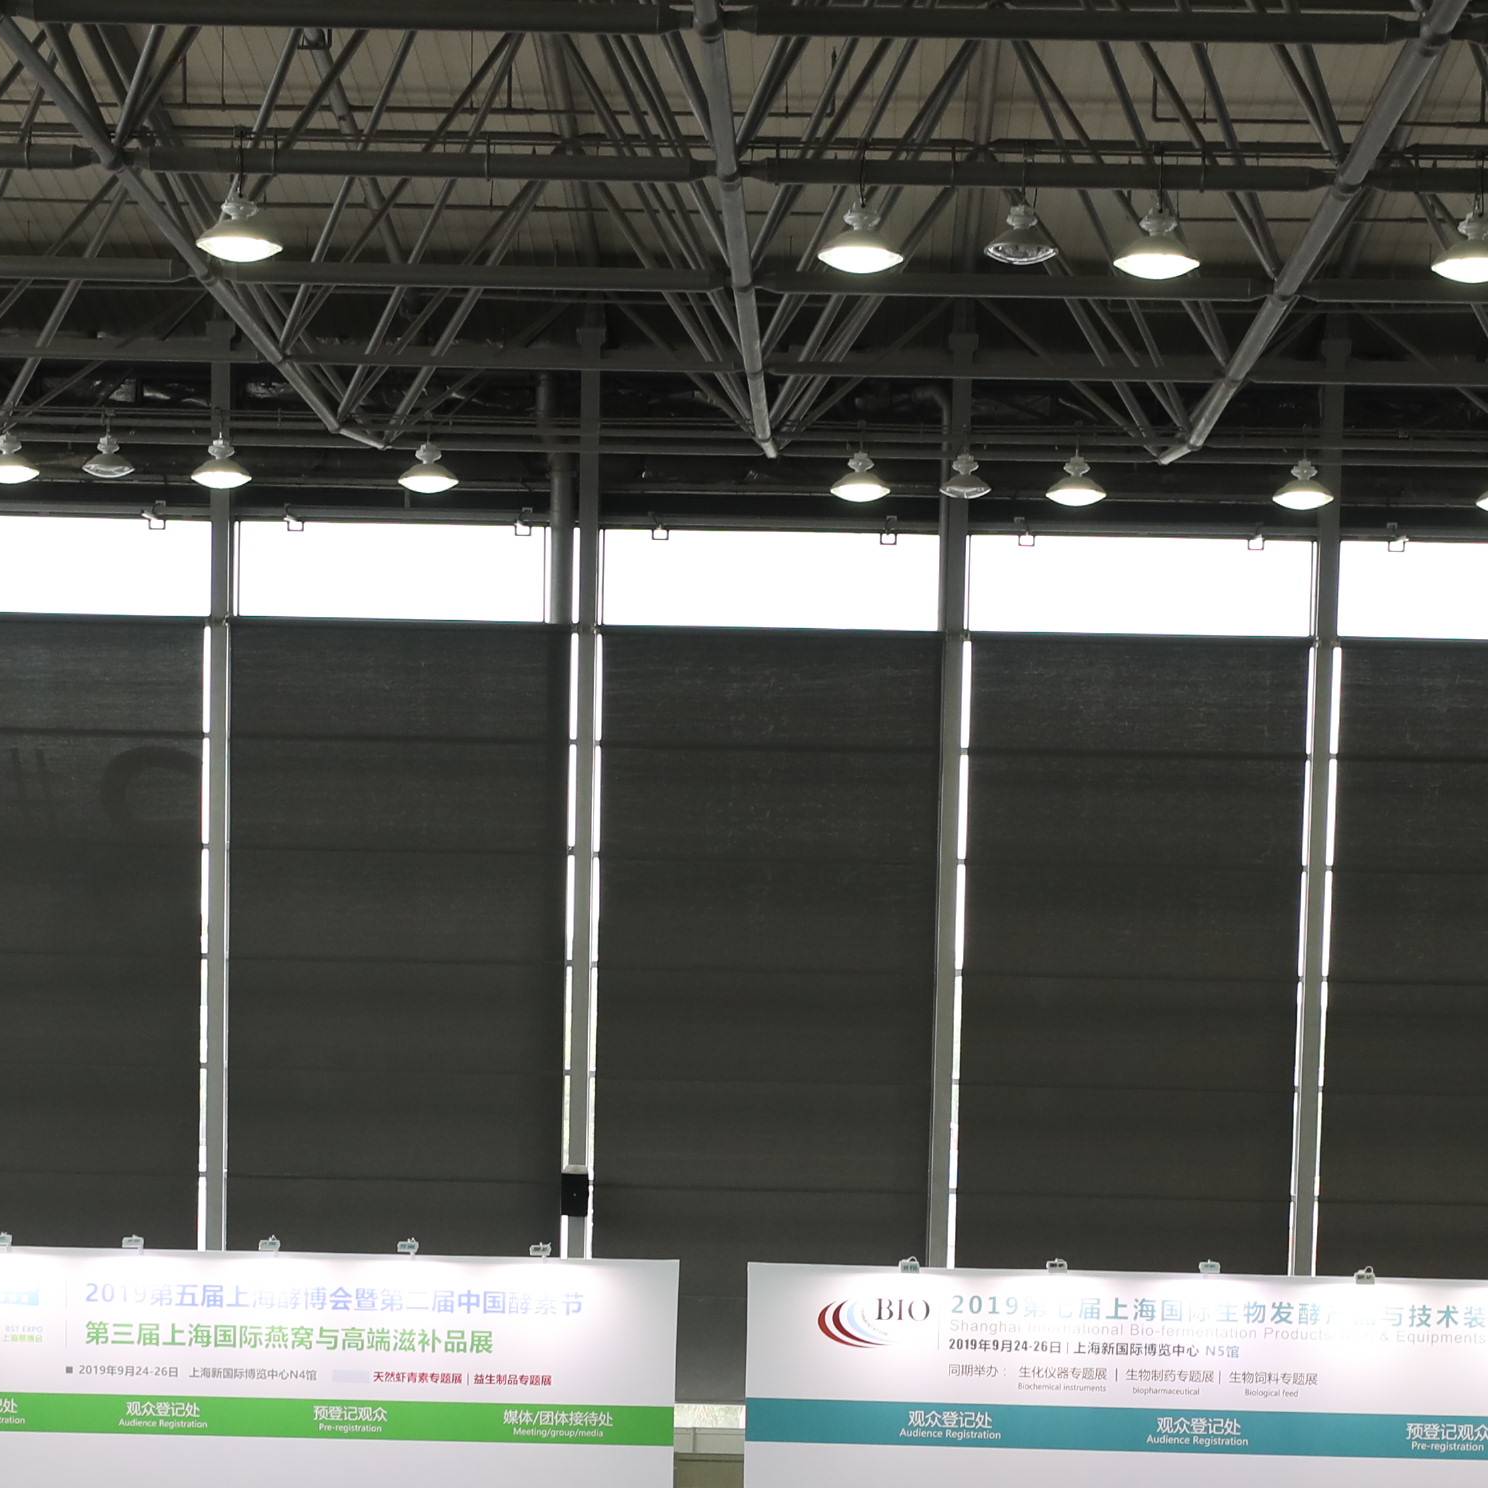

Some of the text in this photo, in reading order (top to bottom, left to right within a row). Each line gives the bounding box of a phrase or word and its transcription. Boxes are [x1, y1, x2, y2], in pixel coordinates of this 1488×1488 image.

[875, 1298, 930, 1323] BIO
[85, 1319, 494, 1355] 第三届上海国际燕窝与高端滋补品展
[949, 1319, 1021, 1336] Shanghai
[1396, 1330, 1486, 1345] Equipments
[948, 1337, 1241, 1359] 2019年9月24-26日 上海新国际博览中心 N5馆
[78, 1364, 553, 1387] 2019年9月24-26日 上海新国际博览中心N4馆 天然虾青素专题展 益生制品专题展
[1018, 1365, 1108, 1381] 生化仪器专题展
[1125, 1368, 1215, 1384] 生物制药专题展
[1229, 1370, 1319, 1387] 生物饲料专题展
[1063, 1384, 1107, 1394] instruments
[1282, 1389, 1299, 1398] feed
[125, 1400, 201, 1419] 观众登记处
[313, 1405, 388, 1424] 预登记观众
[502, 1409, 614, 1429] 媒体/团体接待处
[908, 1410, 993, 1430] 观众登记处
[1156, 1416, 1241, 1436] 观众登记处
[118, 1416, 158, 1427] Audience
[160, 1418, 208, 1430] Registration
[318, 1422, 383, 1434] Pre-registration
[512, 1427, 605, 1440] Meeting/group/media
[899, 1427, 943, 1438] Audience
[945, 1428, 1002, 1442] Registration
[1147, 1434, 1191, 1445] Audience
[1193, 1435, 1249, 1448] Registration
[1411, 1440, 1485, 1453] Pre-registration
